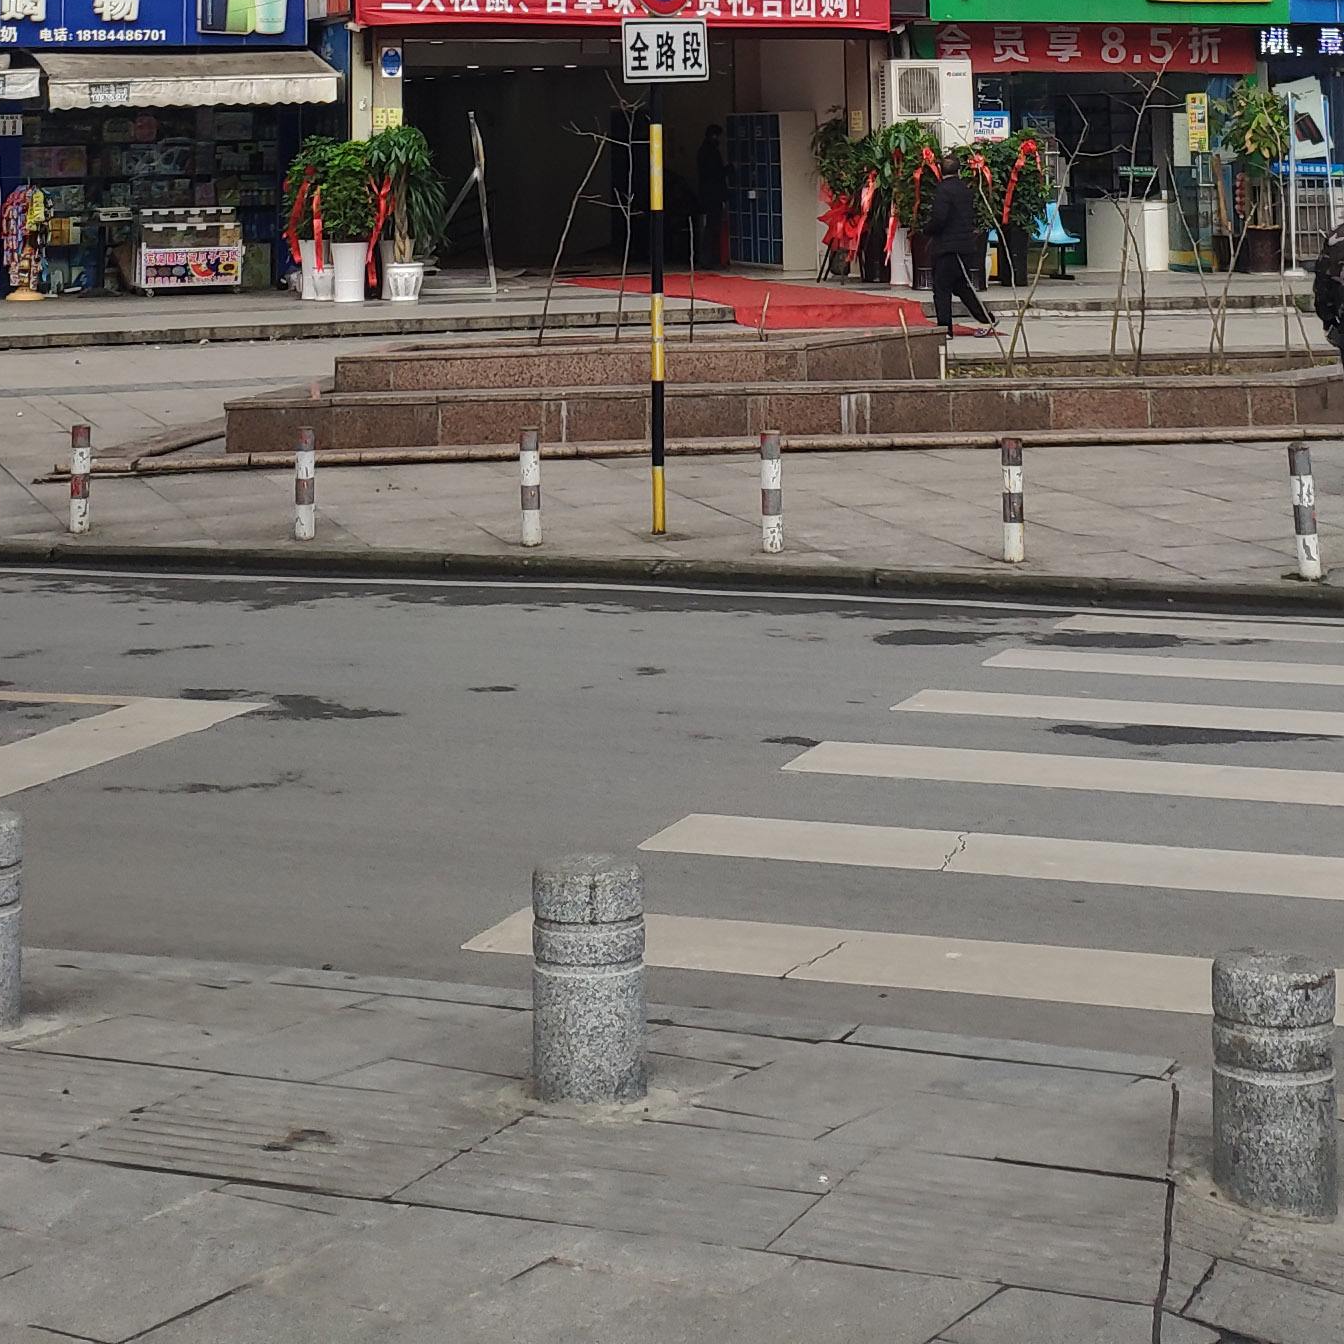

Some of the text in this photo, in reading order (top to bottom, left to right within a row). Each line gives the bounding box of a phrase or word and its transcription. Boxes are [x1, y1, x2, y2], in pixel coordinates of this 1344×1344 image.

[76, 29, 166, 43] 18184486701
[629, 31, 703, 76] 全路段
[935, 24, 1223, 65] 会员享8.5折
